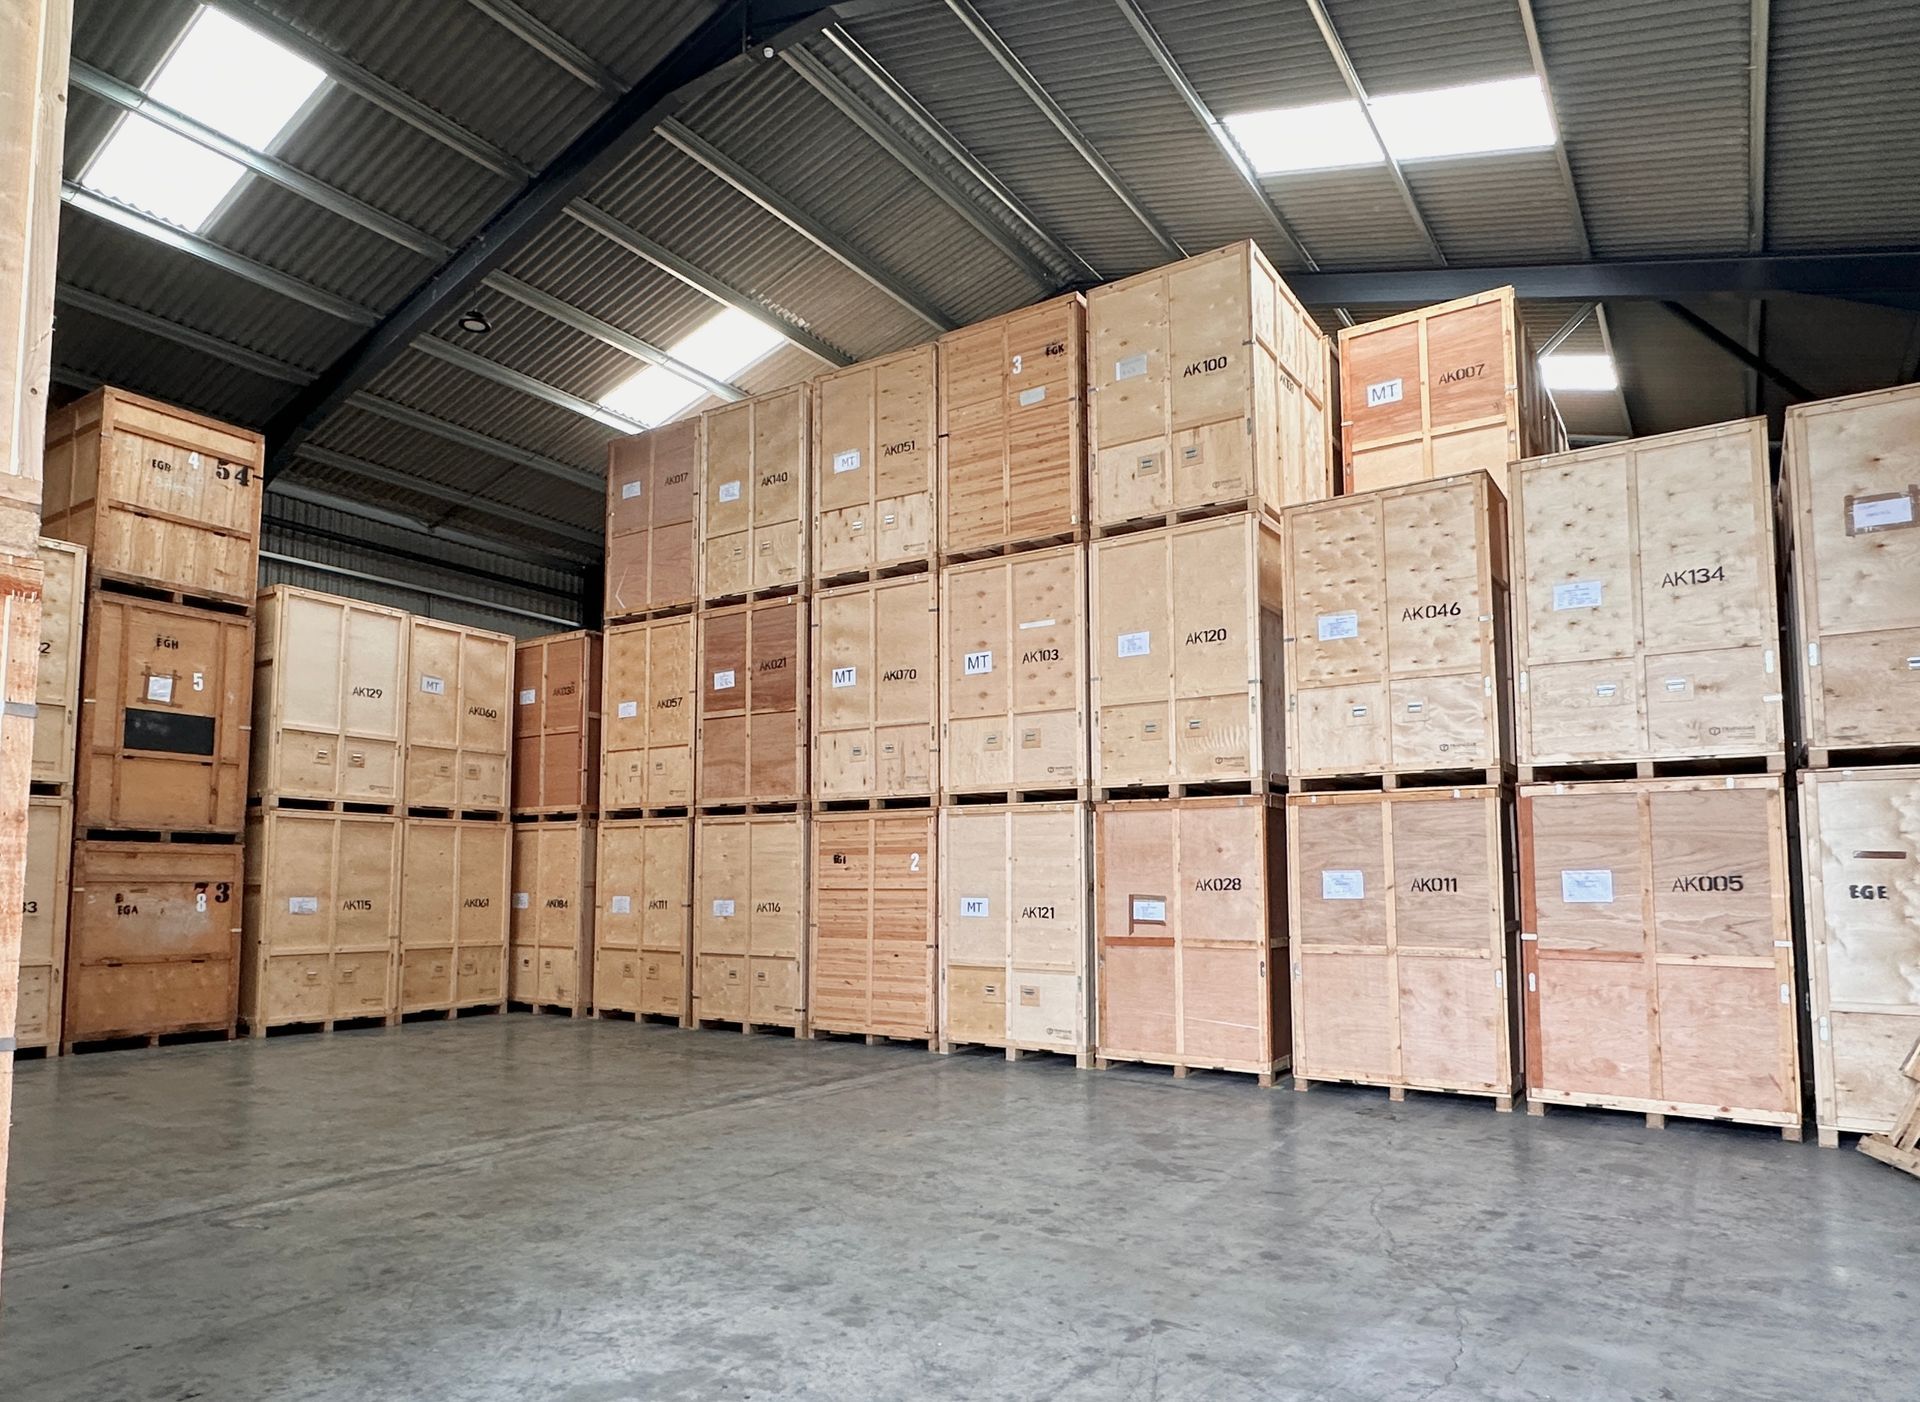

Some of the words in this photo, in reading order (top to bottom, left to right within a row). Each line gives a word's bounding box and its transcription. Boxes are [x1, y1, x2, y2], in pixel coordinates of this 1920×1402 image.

[1012, 354, 1022, 375] 3
[1183, 356, 1228, 377] AK100
[1438, 363, 1486, 386] AK007
[1371, 383, 1398, 402] MT
[884, 440, 916, 457] AK051
[187, 451, 200, 470] 4
[841, 456, 856, 467] MT
[664, 471, 689, 486] AK017
[760, 471, 788, 487] AK140
[1661, 566, 1726, 589] AK134
[1401, 601, 1462, 623] AK046
[156, 637, 179, 650] EGH
[1185, 628, 1228, 646] AK120
[759, 657, 788, 672] AK021
[967, 654, 989, 670] MT
[1022, 648, 1060, 665] AK103
[192, 672, 204, 692] 5
[834, 669, 853, 684] MT
[883, 668, 917, 682] AK070
[352, 685, 384, 700] AK129
[426, 680, 440, 691] MT
[656, 697, 683, 709] AK057
[910, 852, 920, 872] 2
[1195, 877, 1242, 892] AK028
[1410, 877, 1457, 893] AK011
[1671, 874, 1744, 893] AK005
[1849, 884, 1889, 900] EGE
[117, 904, 139, 916] EGA
[196, 893, 207, 913] 8
[342, 899, 372, 912] AK115
[756, 902, 781, 913] AK116
[966, 902, 983, 913] MT
[1022, 906, 1056, 919] AK121
